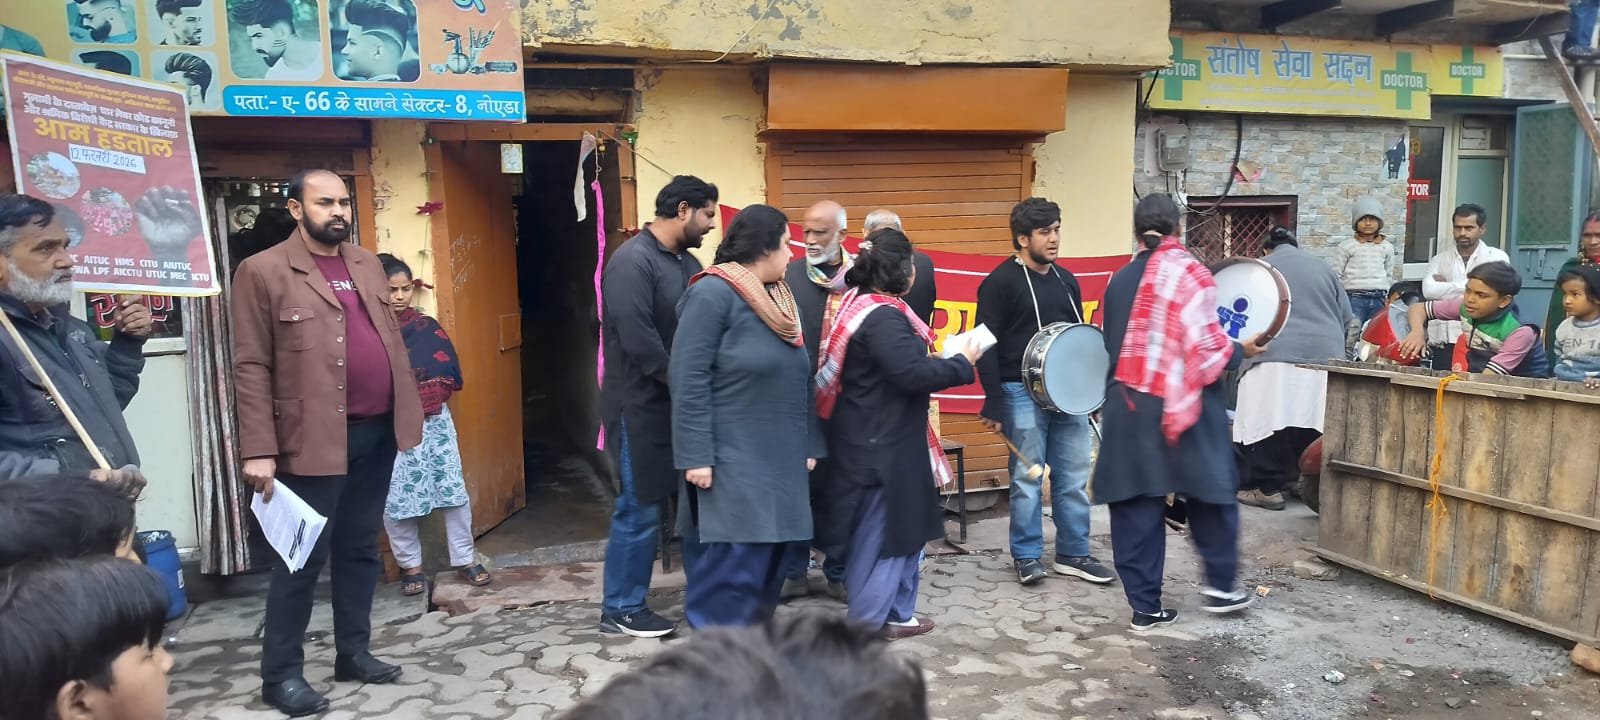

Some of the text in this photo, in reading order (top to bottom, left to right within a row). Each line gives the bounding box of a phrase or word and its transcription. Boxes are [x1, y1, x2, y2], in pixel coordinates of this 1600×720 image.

[1206, 37, 1262, 77] संतोष
[1271, 40, 1314, 79] सेवा
[1151, 62, 1197, 77] CTOR
[1451, 64, 1483, 77] DOCTOR
[1383, 73, 1424, 89] DOCTOR
[52, 95, 62, 107] के
[304, 90, 331, 111] 66
[334, 91, 350, 111] के
[353, 92, 399, 112] सामने
[455, 95, 473, 117] 8,
[477, 95, 521, 117] नोएडा
[23, 104, 41, 116] और
[139, 123, 149, 135] के
[33, 117, 90, 145] आम
[113, 154, 137, 168] 2026
[83, 255, 110, 265] AITUC
[114, 257, 135, 266] HMS
[140, 259, 158, 268] CITU
[93, 266, 110, 276] LPF
[145, 269, 168, 279] UTUC
